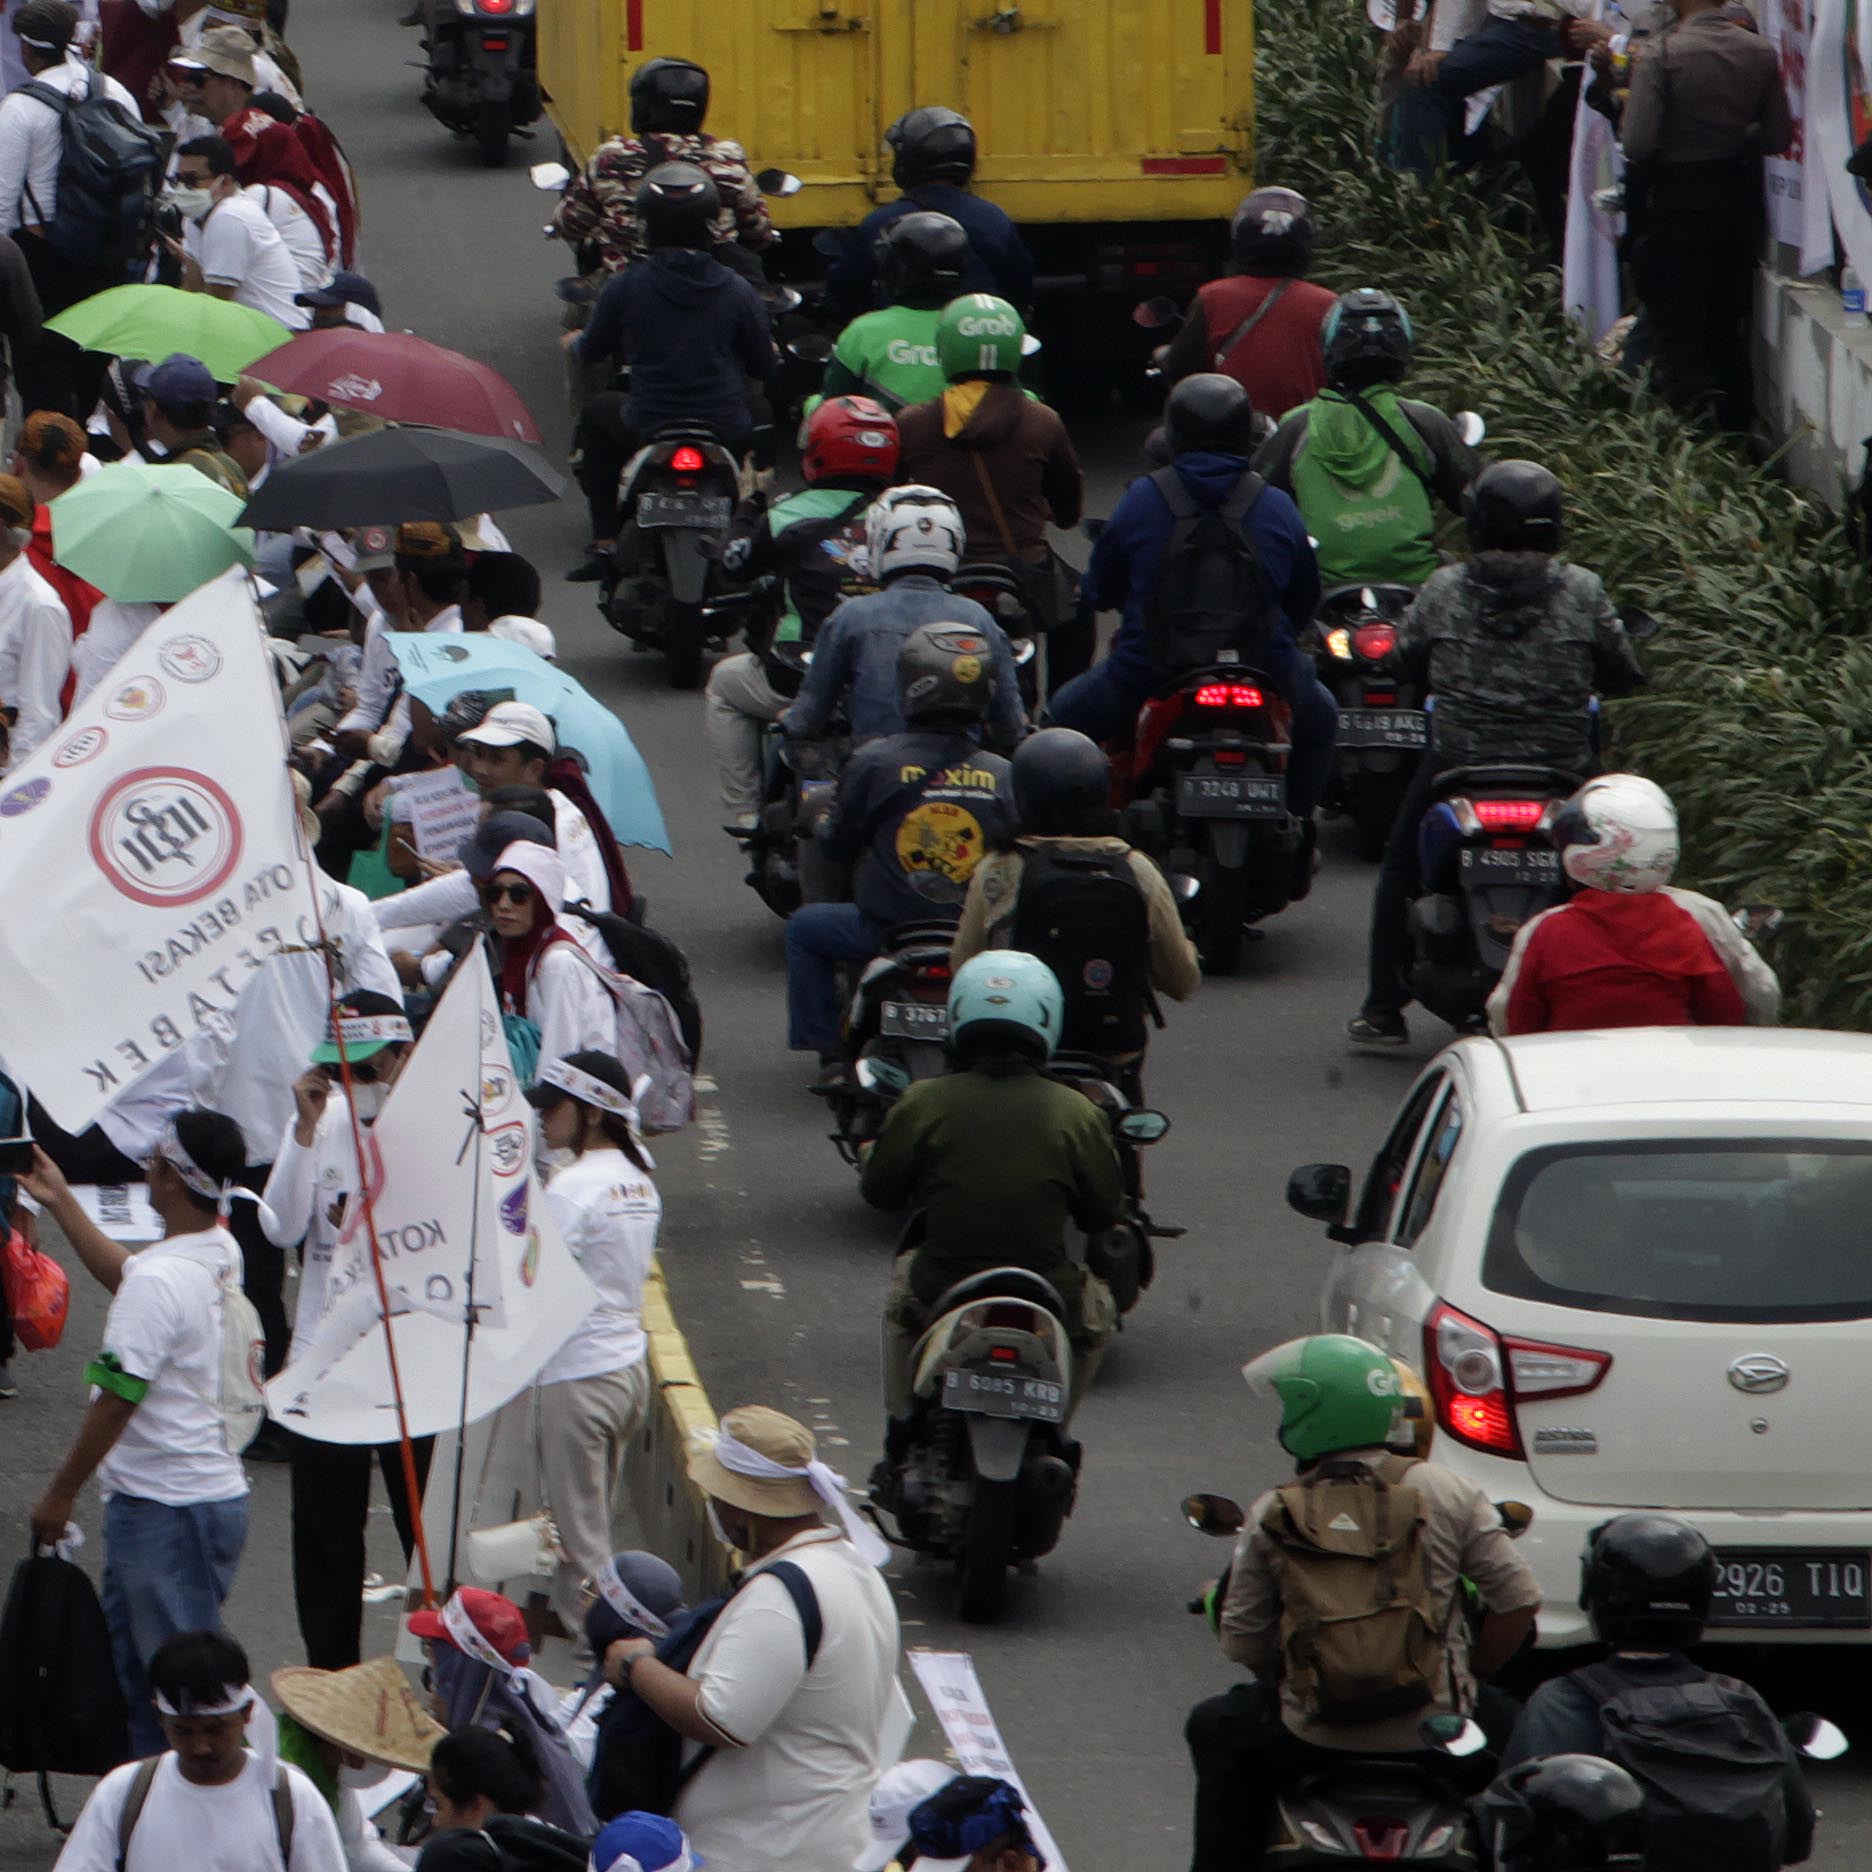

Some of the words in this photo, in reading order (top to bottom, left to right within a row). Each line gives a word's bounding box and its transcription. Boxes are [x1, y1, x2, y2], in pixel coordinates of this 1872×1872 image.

[959, 312, 1017, 337] Grab
[888, 340, 942, 367] Gra
[946, 1371, 958, 1389] B
[1805, 1562, 1865, 1598] TIQ
